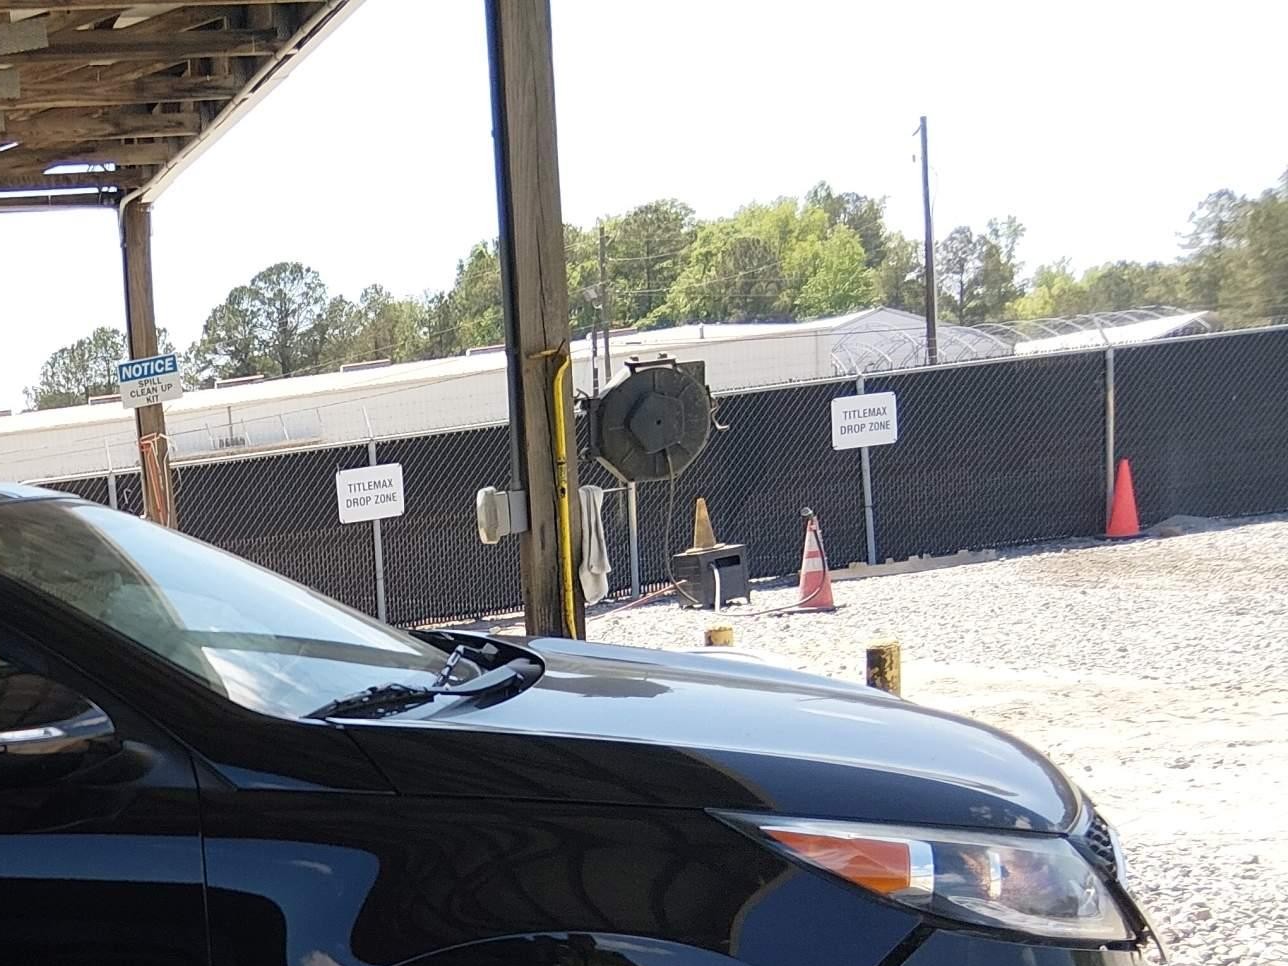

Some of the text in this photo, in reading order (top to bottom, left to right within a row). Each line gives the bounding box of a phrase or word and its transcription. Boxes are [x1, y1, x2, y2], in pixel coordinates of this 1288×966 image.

[122, 357, 174, 380] NOTICE
[138, 377, 162, 388] SPILL
[130, 383, 173, 398] CLEAN UP
[146, 395, 159, 403] KIT
[842, 406, 887, 420] TITLEMAX
[840, 420, 891, 435] DROP ZONE
[348, 479, 394, 493] TITLEMAX
[346, 492, 397, 508] DROP ZONE
